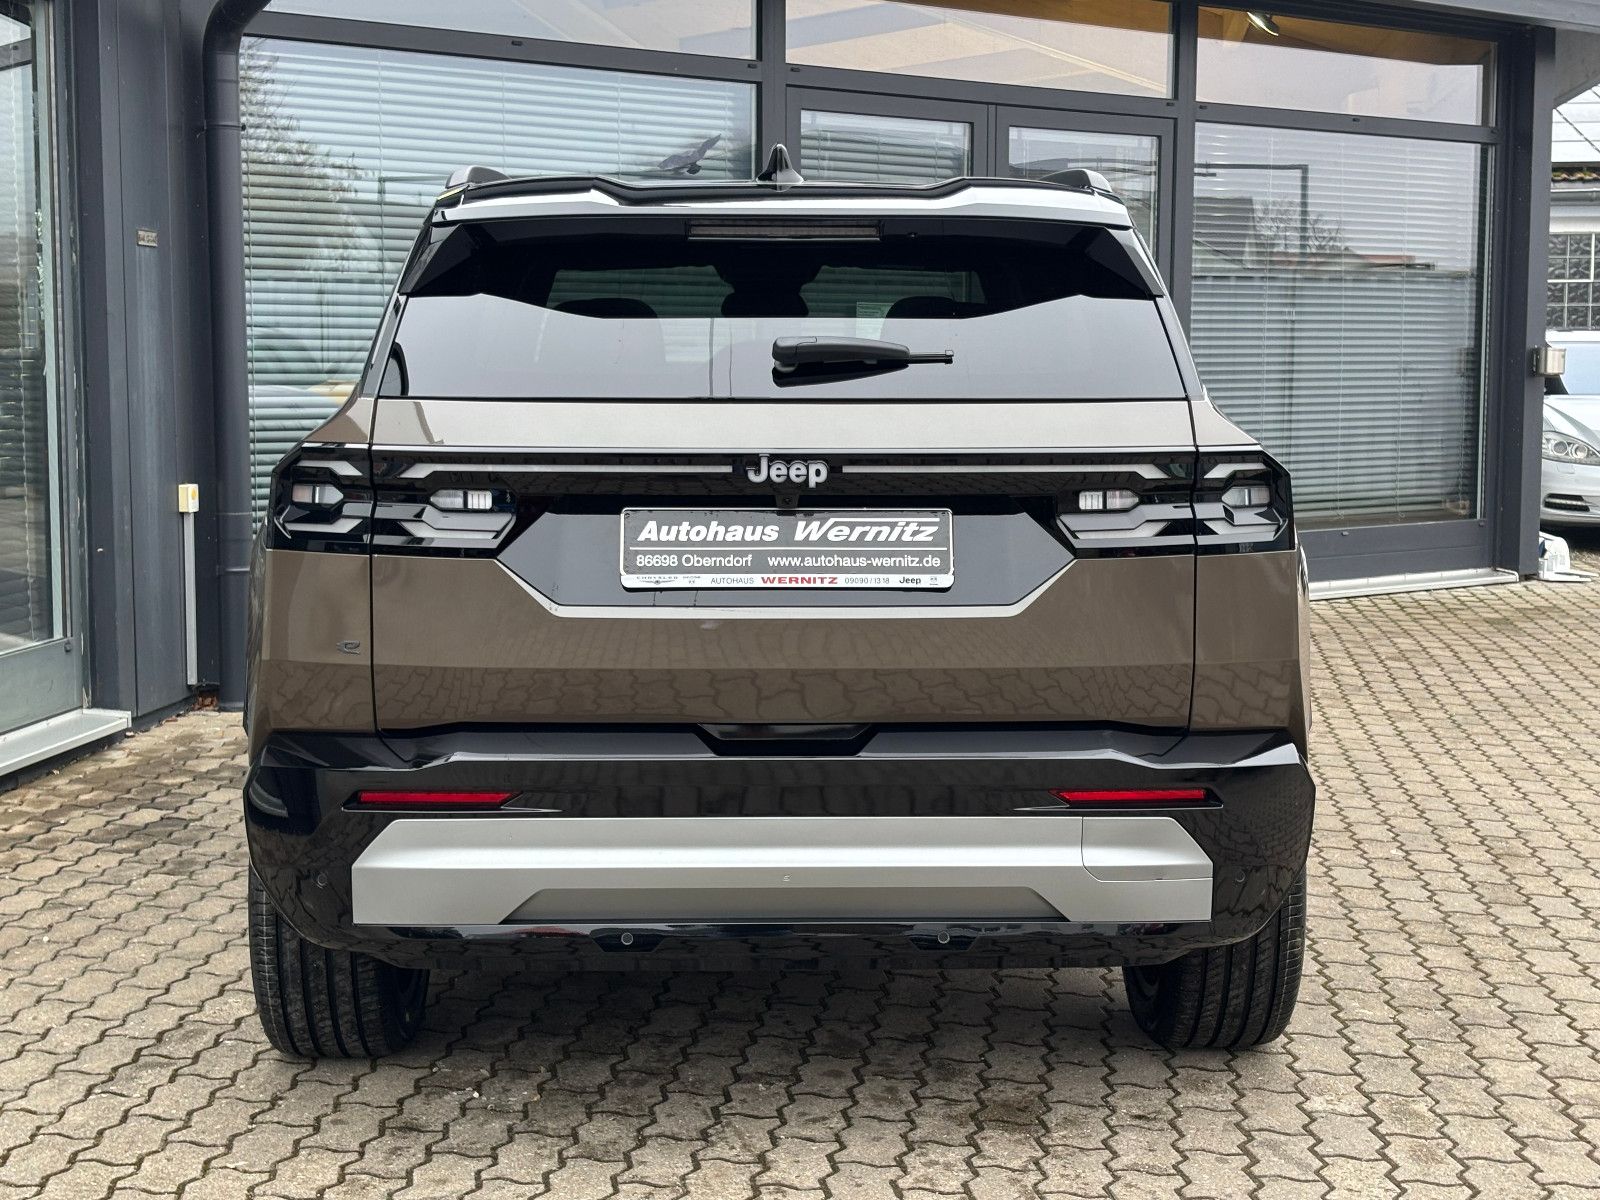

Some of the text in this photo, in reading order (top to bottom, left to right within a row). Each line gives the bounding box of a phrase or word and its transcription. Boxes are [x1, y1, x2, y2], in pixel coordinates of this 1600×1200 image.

[746, 453, 828, 488] Jeep
[637, 518, 940, 542] Autohaus Wernitz
[636, 554, 941, 567] 86698 Oberndorf www.autohaus-wernitz.de
[710, 577, 755, 585] AUTOHAUS
[761, 576, 838, 585] WERNITZ
[899, 576, 922, 585] Jeep
